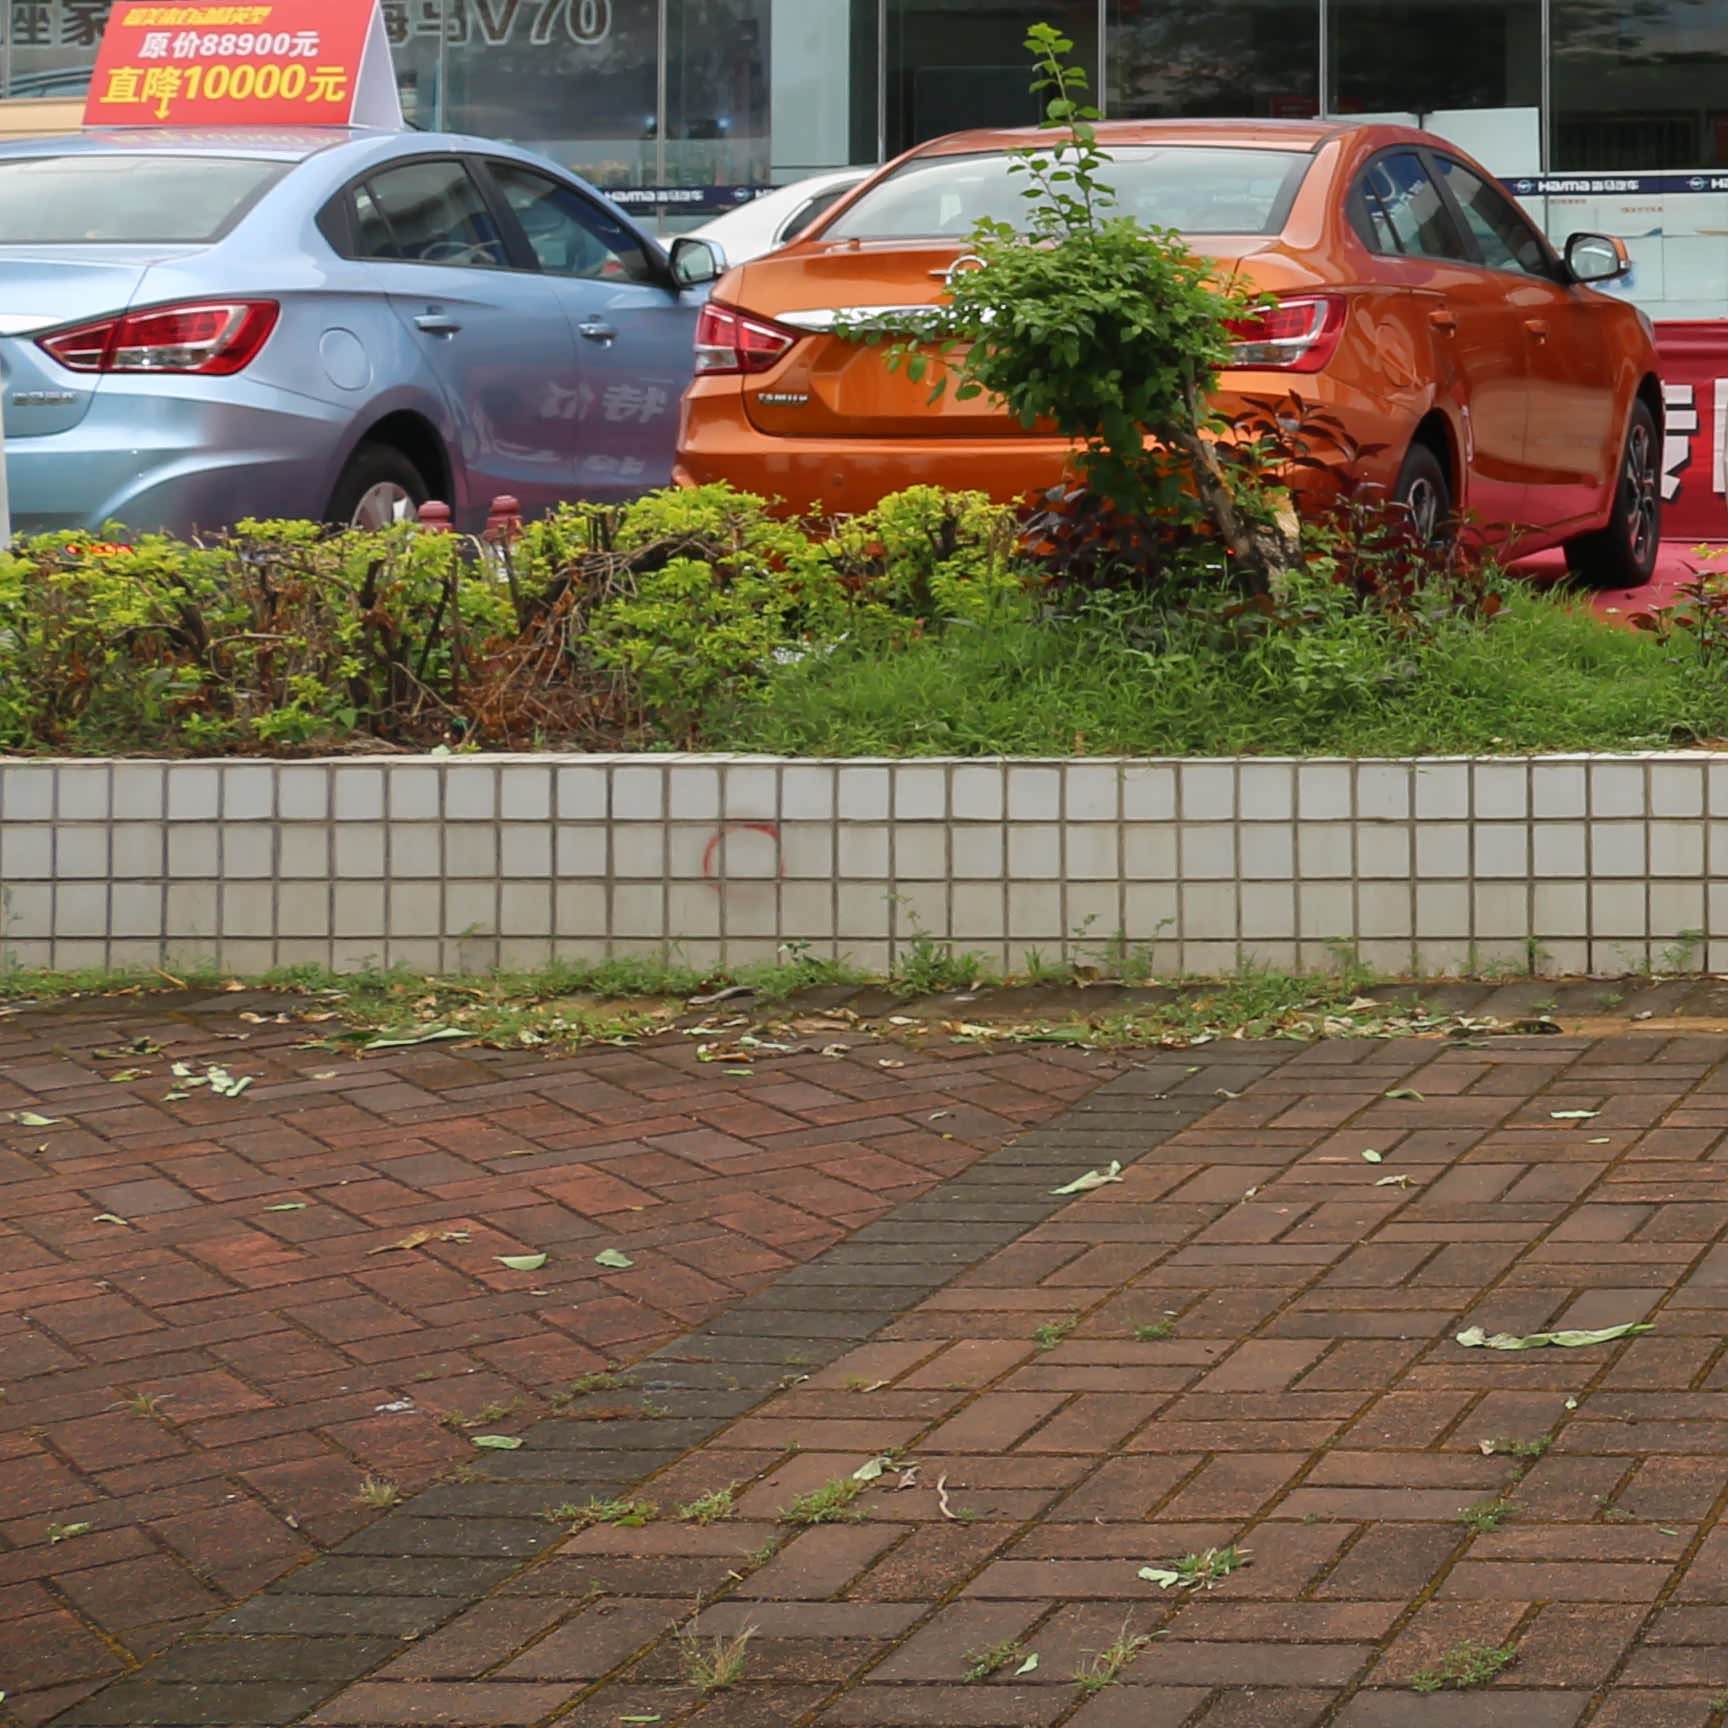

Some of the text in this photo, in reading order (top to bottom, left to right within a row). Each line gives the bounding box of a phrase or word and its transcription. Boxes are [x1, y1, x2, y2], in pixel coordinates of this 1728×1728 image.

[137, 31, 320, 60] 原价88900元
[99, 64, 348, 106] 直降10000元
